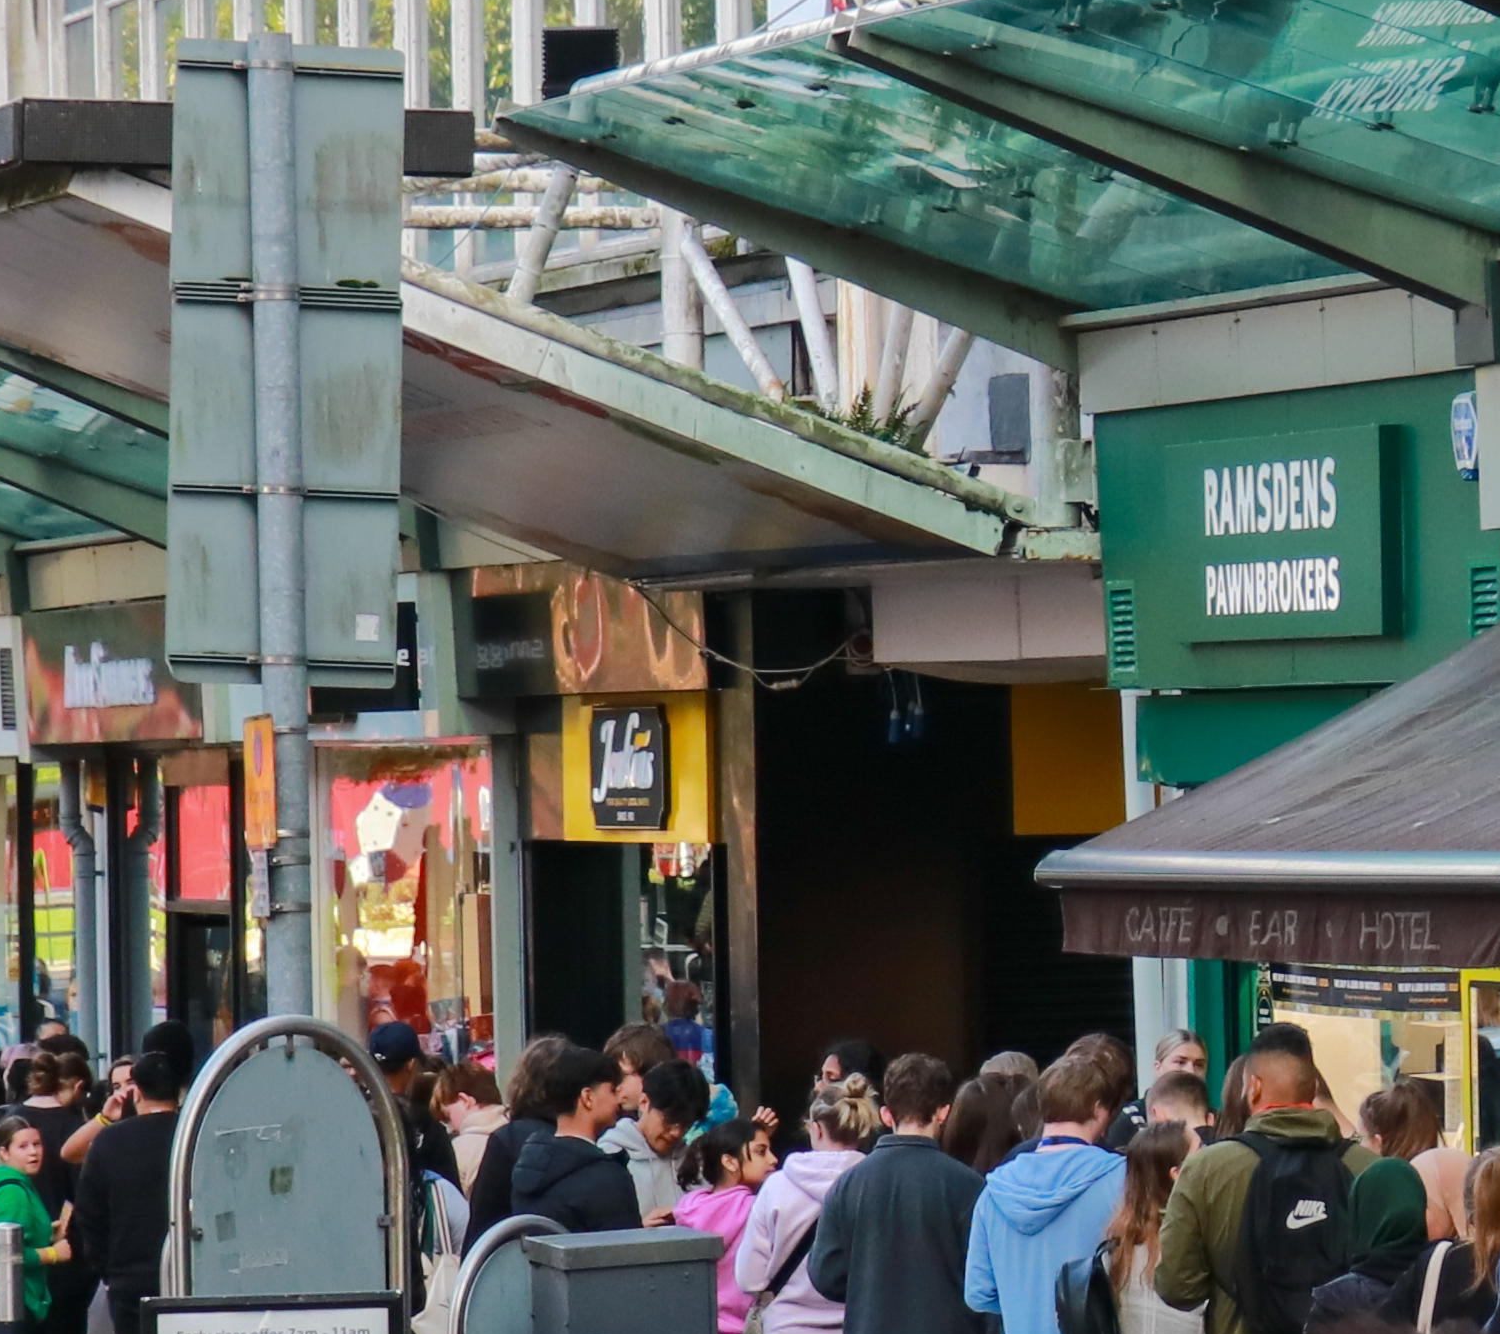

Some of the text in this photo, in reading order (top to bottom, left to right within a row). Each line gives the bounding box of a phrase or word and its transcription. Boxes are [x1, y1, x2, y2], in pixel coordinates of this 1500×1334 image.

[1204, 456, 1337, 536] RAMSDENS
[1205, 556, 1341, 616] PAWNBROKERS
[1125, 898, 1193, 943] CAFFÉ
[1359, 910, 1439, 951] HOTEL
